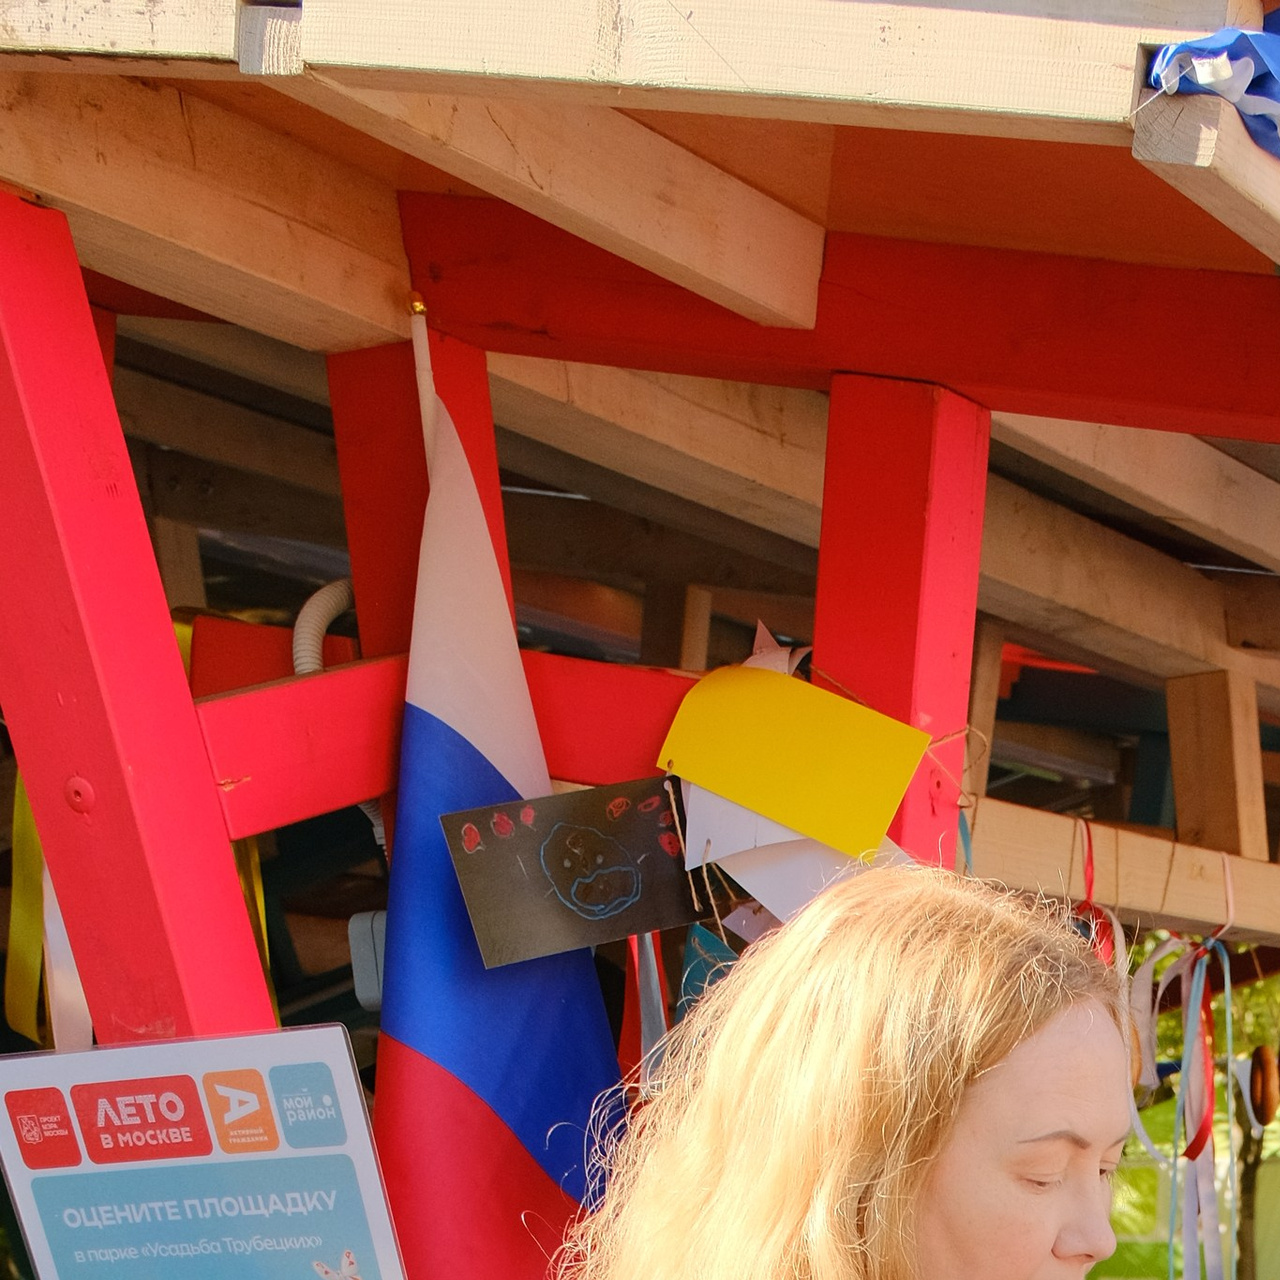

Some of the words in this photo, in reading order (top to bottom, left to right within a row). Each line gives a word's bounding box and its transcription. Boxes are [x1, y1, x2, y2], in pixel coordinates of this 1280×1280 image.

[97, 1092, 185, 1127] ЛЕТО
[100, 1134, 114, 1149] В
[117, 1126, 193, 1148] МОСКВЕ
[63, 1200, 182, 1230] ОЦЕНИТЕ
[184, 1190, 337, 1219] ПЛОЩАДКУ
[75, 1251, 86, 1263] в
[88, 1247, 140, 1264] парке
[142, 1239, 222, 1259] «Усадьба
[222, 1235, 324, 1256] Трубецких»
